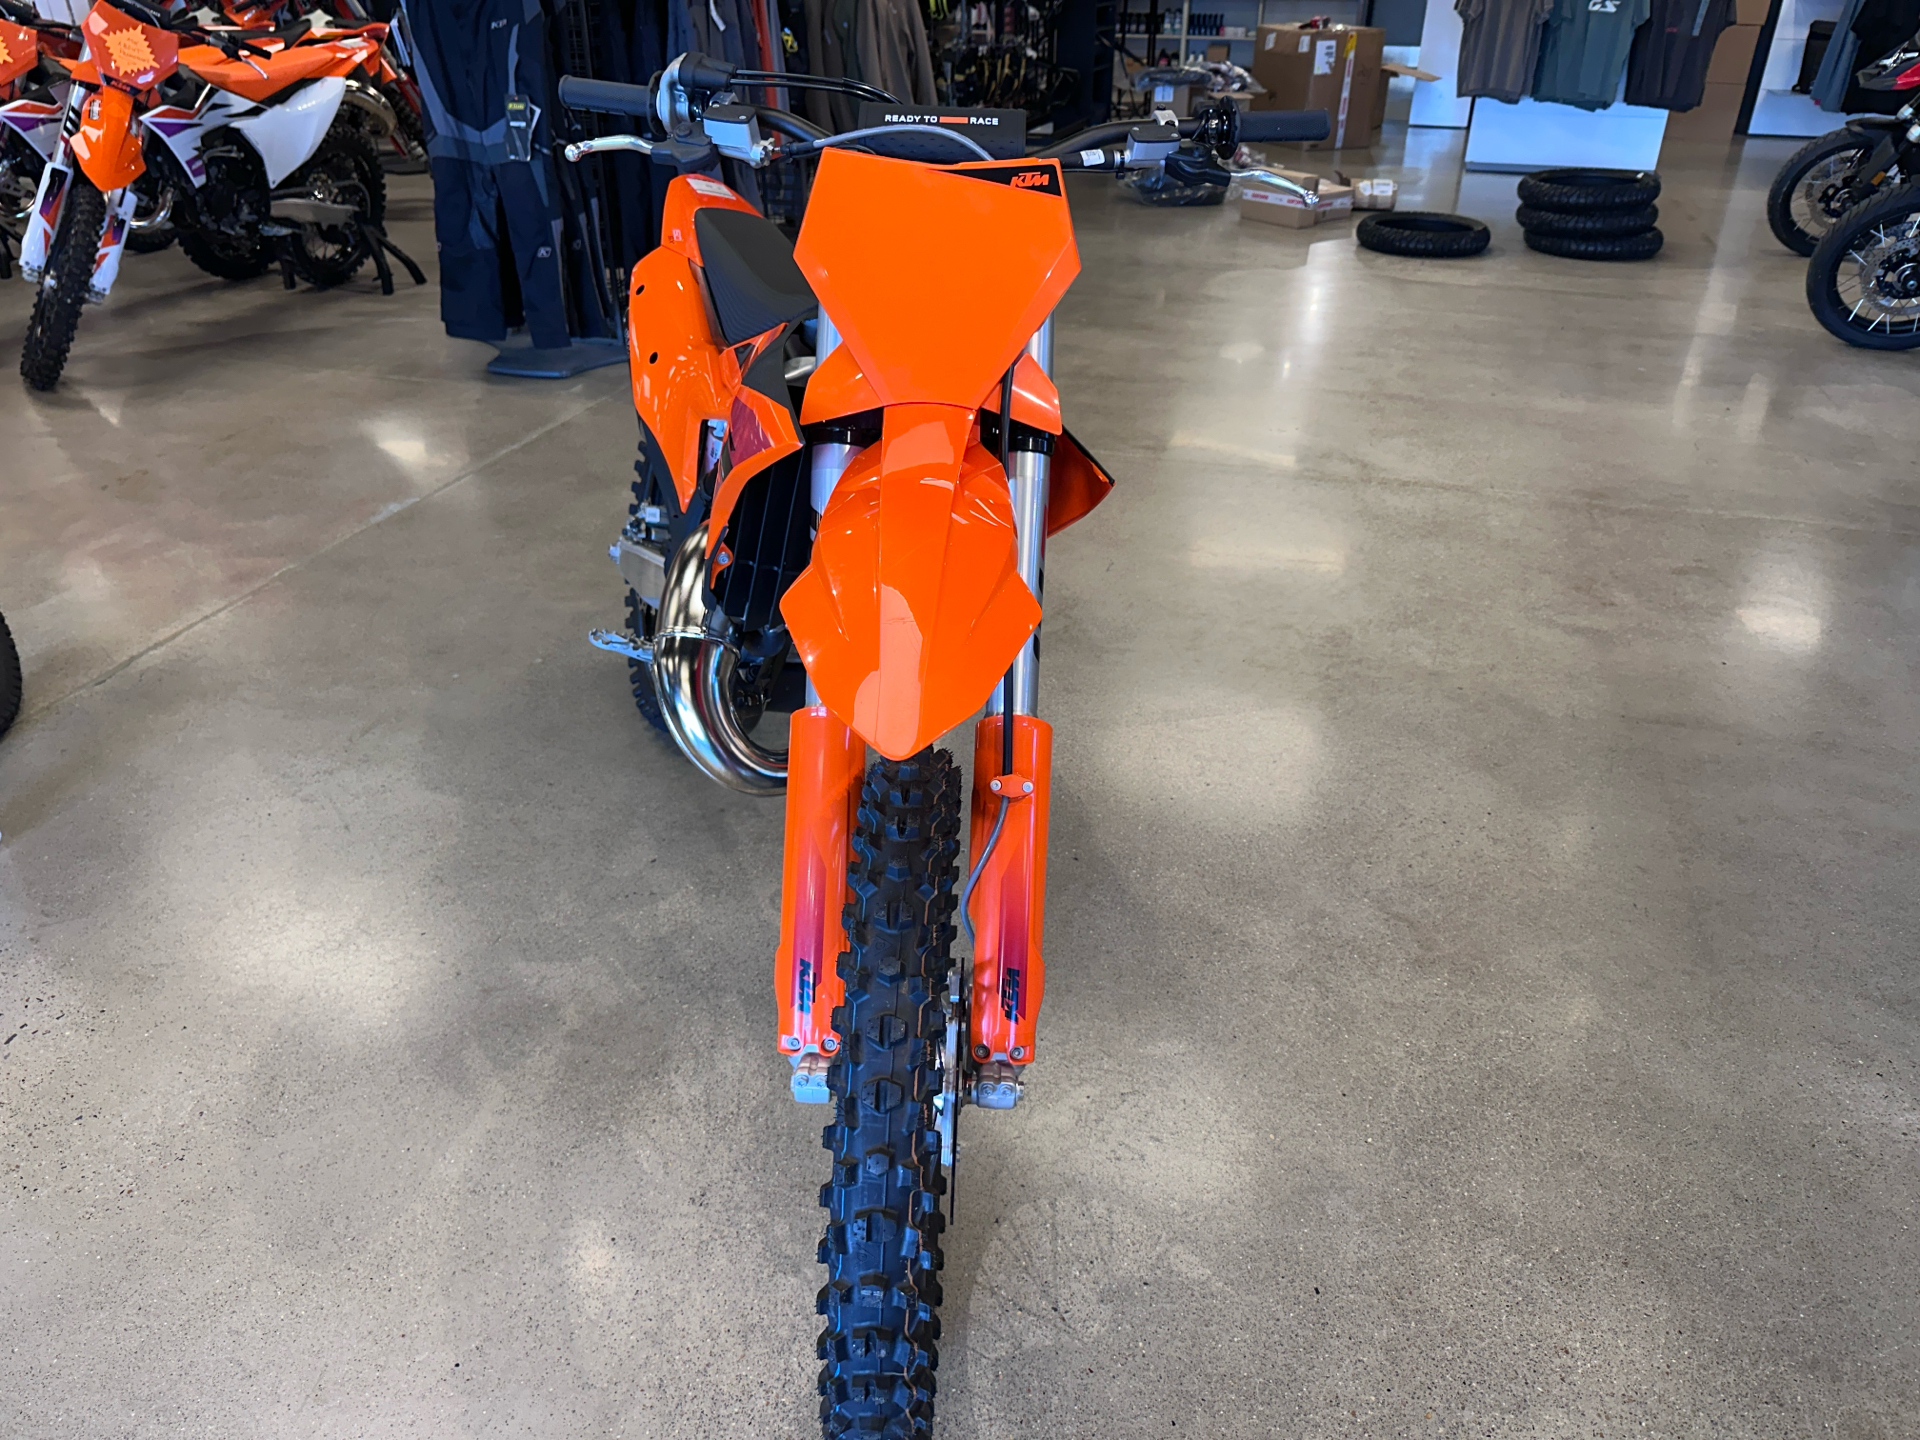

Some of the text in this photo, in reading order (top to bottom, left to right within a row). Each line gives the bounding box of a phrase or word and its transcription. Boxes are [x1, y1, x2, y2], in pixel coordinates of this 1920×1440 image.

[884, 114, 999, 126] READY TO RACE
[1009, 171, 1050, 188] KTM
[798, 957, 817, 1015] KTM
[1000, 967, 1020, 1025] KTM
